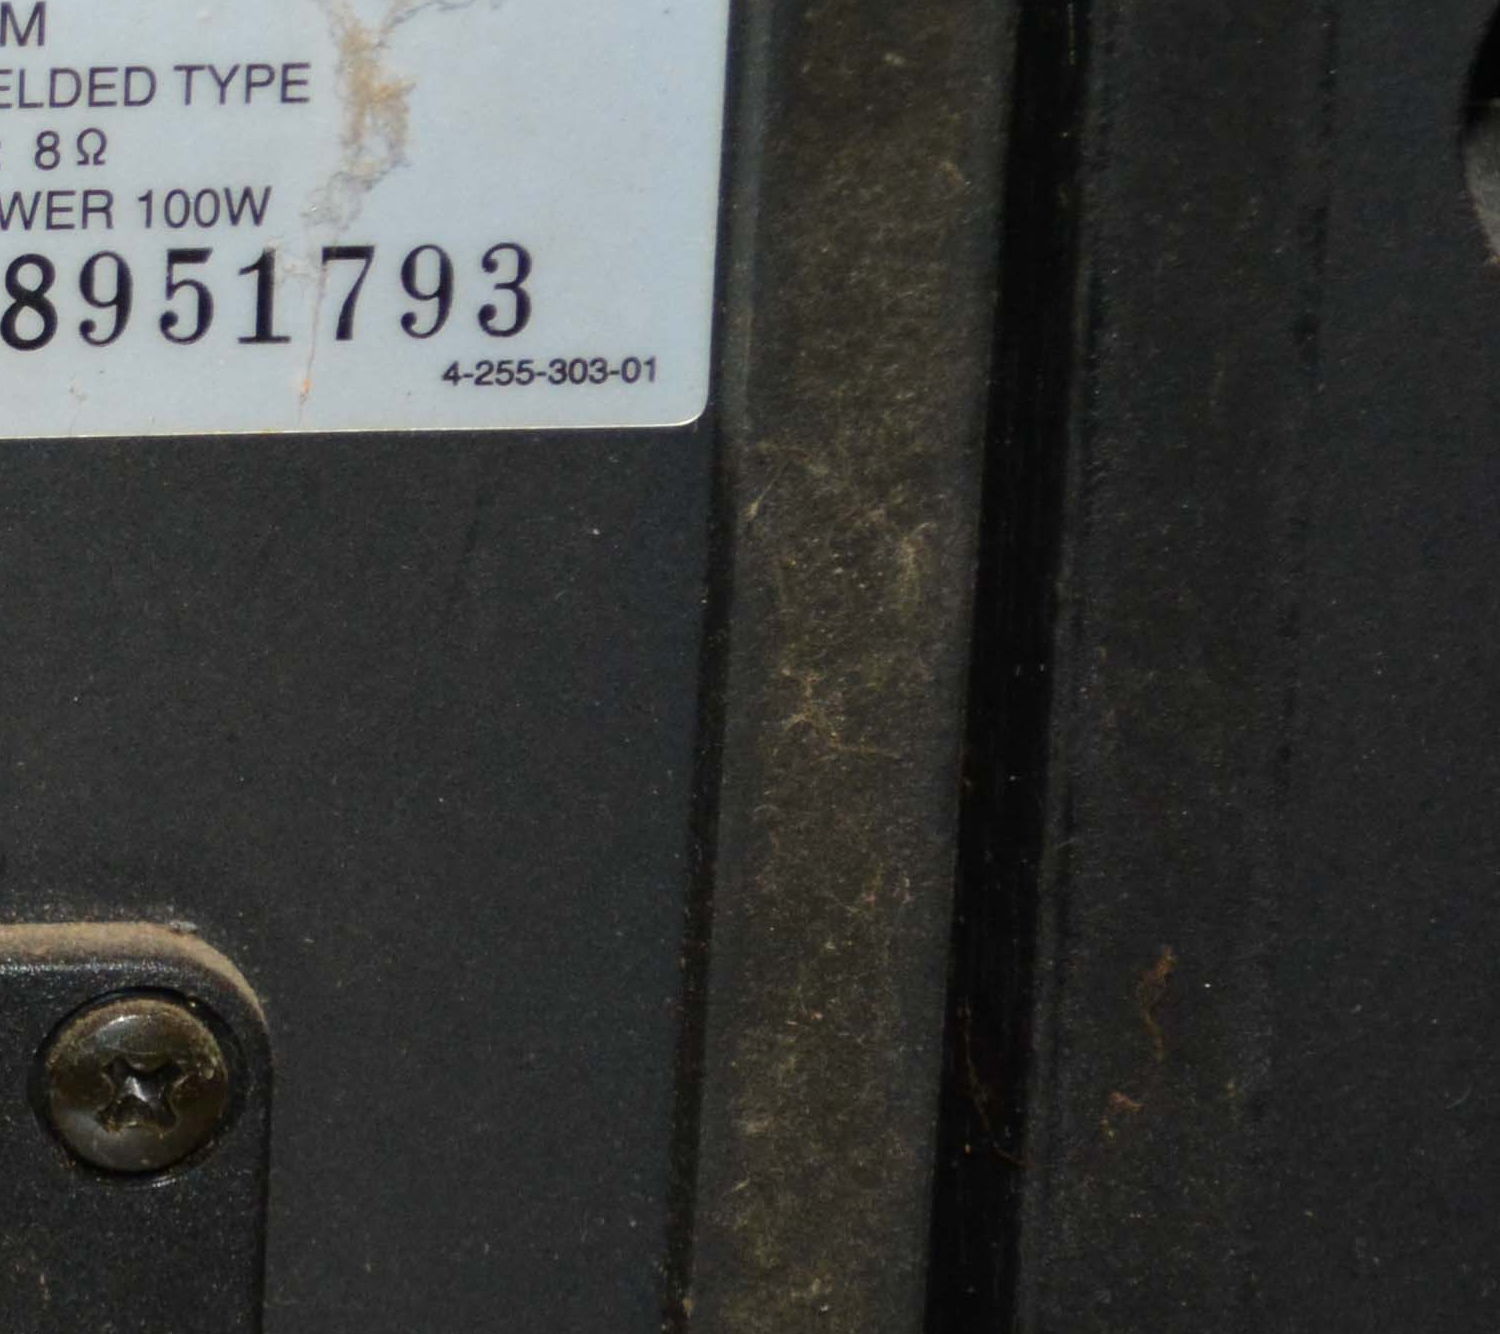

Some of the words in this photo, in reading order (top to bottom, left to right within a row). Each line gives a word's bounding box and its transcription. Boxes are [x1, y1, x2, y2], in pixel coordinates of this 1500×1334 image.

[173, 62, 311, 106] TYPE
[137, 186, 272, 229] 100W
[0, 242, 532, 352] 8951793
[441, 356, 656, 387] 4-255-303-01
